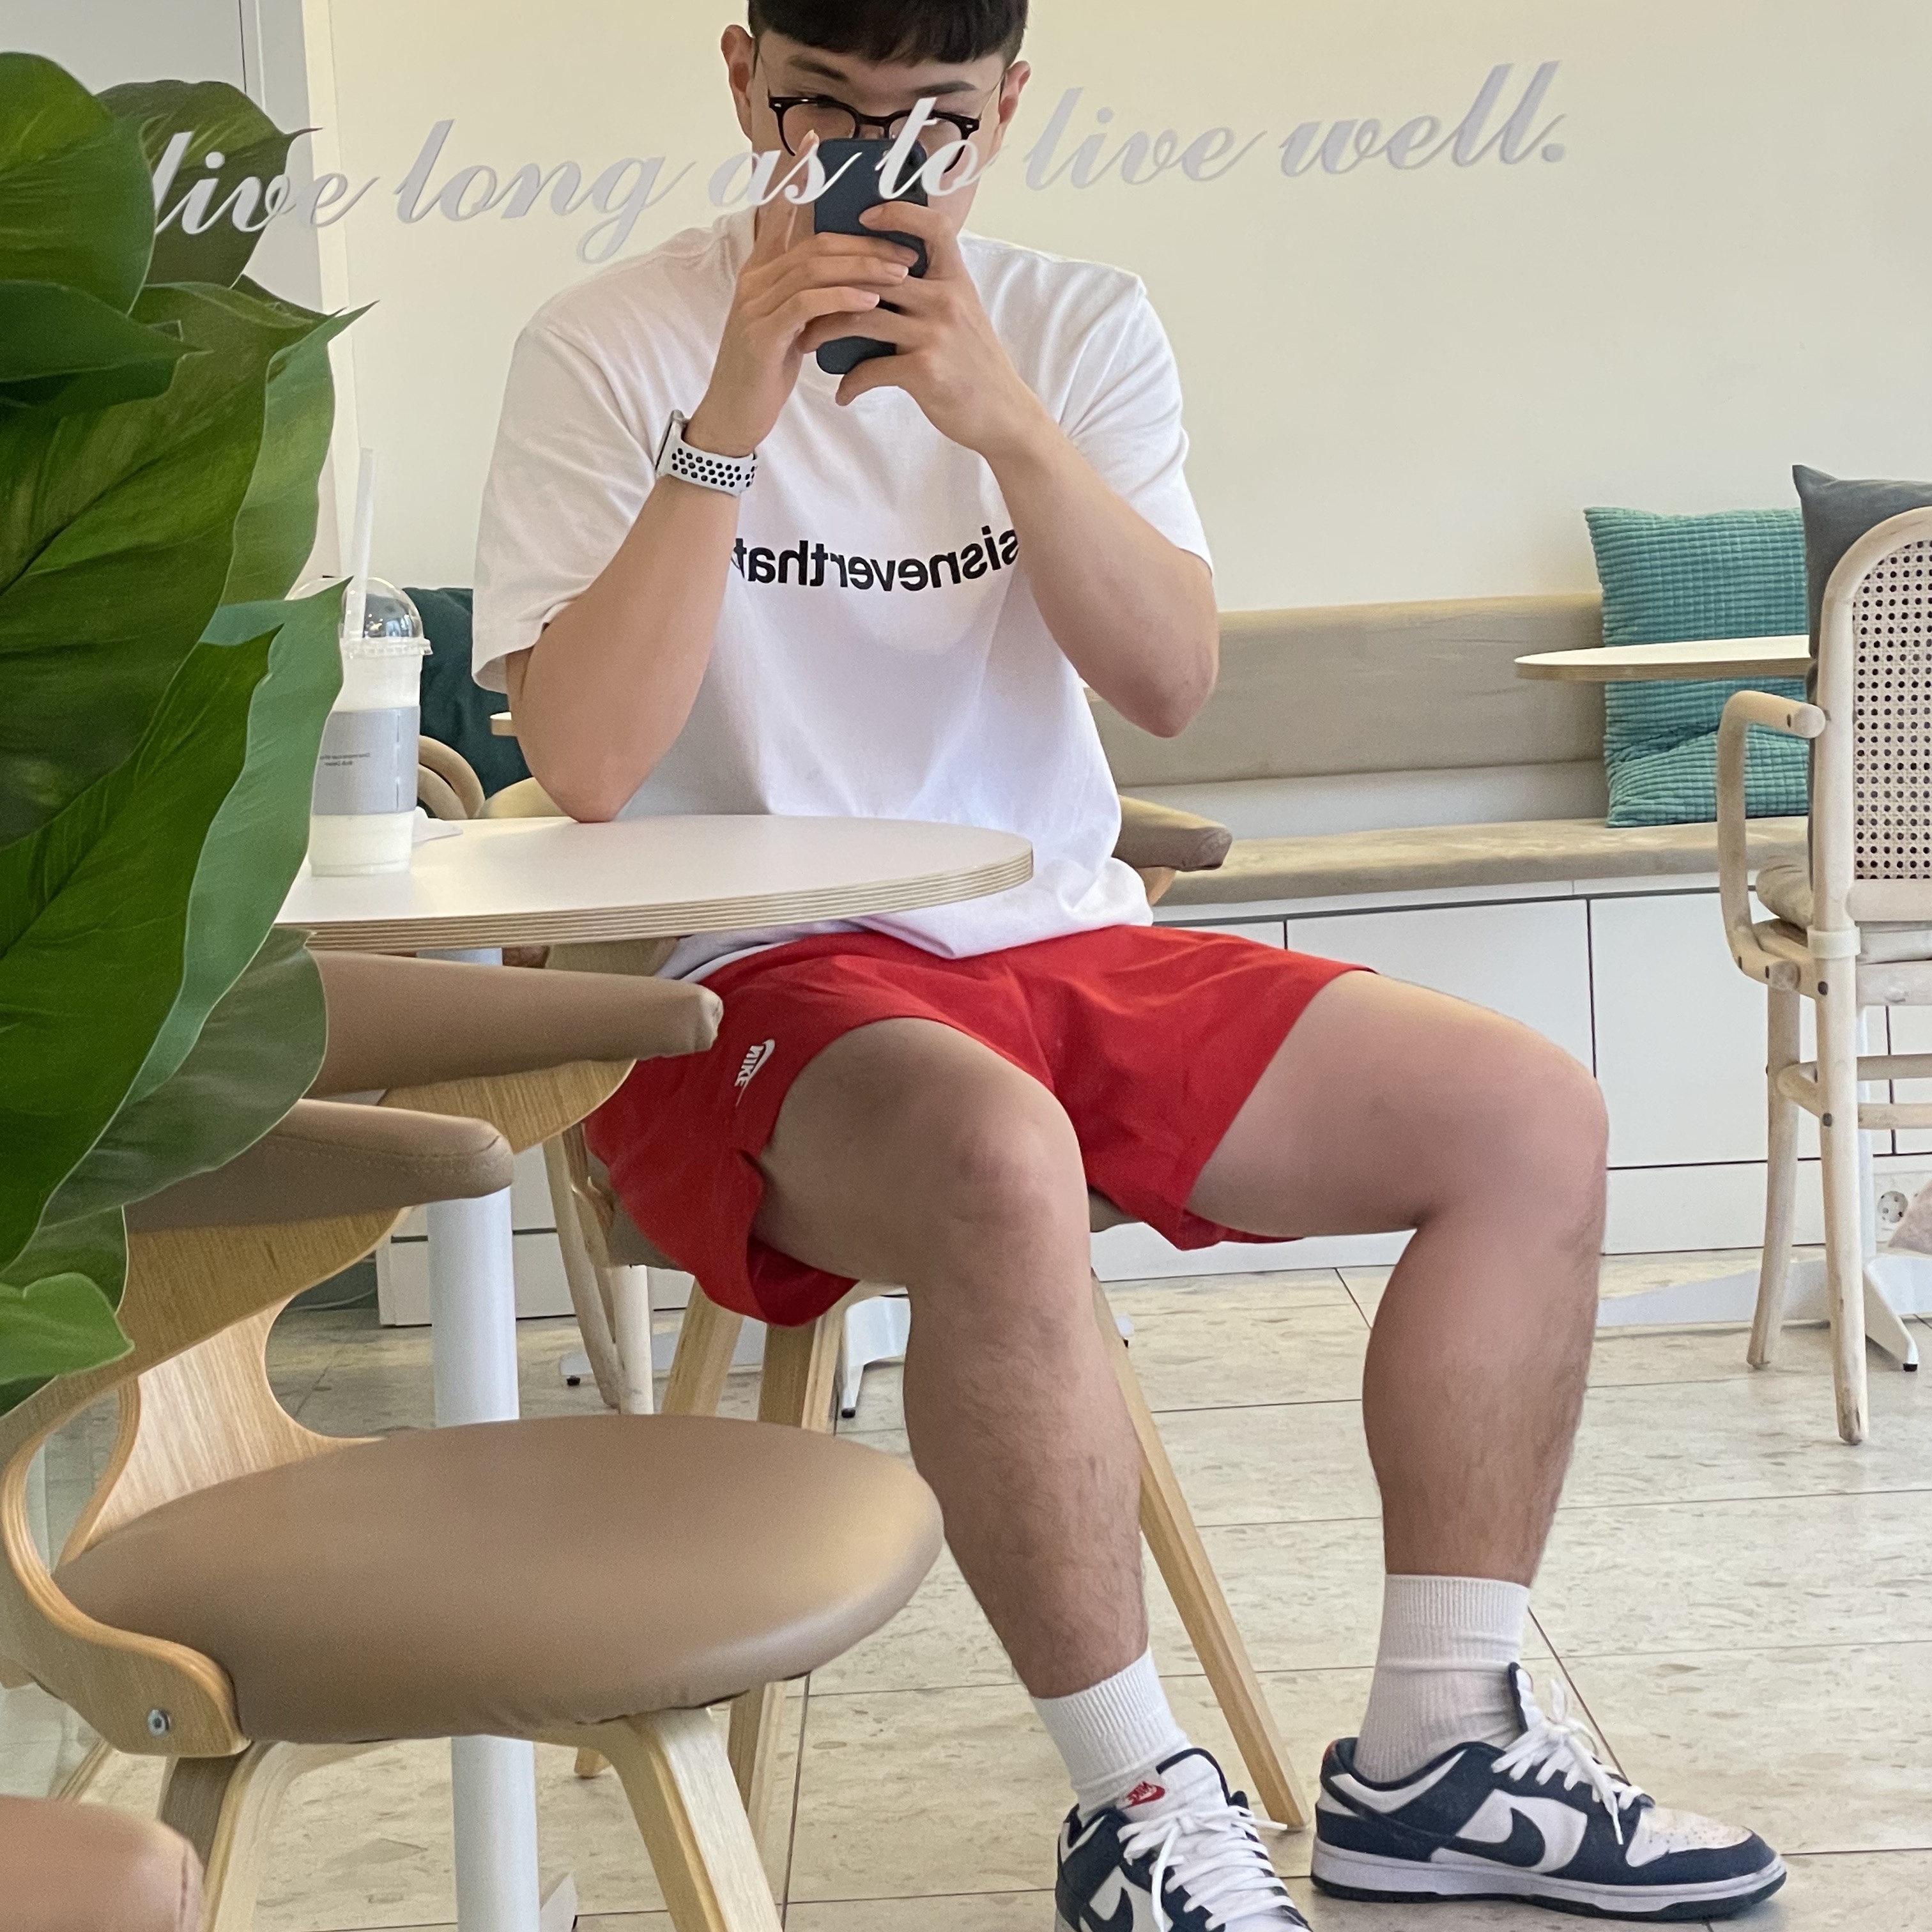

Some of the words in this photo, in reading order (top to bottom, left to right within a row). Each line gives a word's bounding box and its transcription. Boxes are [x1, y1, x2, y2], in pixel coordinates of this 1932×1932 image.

[153, 131, 379, 235] live
[394, 119, 696, 264] long
[707, 133, 862, 208] as
[875, 96, 1009, 200] to
[1024, 87, 1268, 191] live
[1279, 59, 1567, 178] well.
